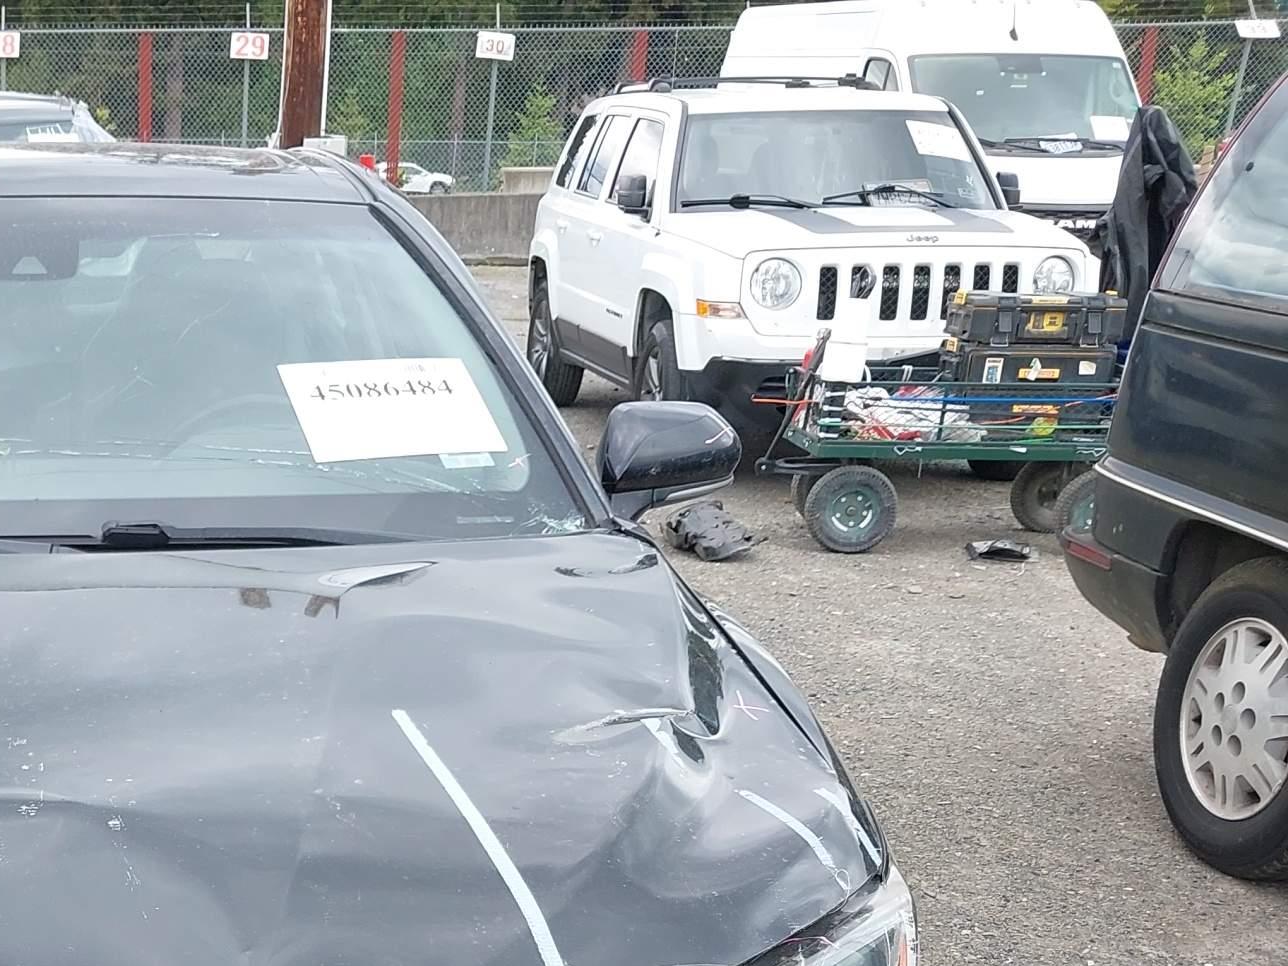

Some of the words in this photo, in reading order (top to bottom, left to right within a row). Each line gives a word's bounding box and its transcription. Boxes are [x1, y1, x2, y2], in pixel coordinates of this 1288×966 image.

[235, 34, 265, 57] 29
[486, 38, 505, 54] 30
[907, 234, 939, 244] Jeep
[310, 379, 454, 401] 45086484
